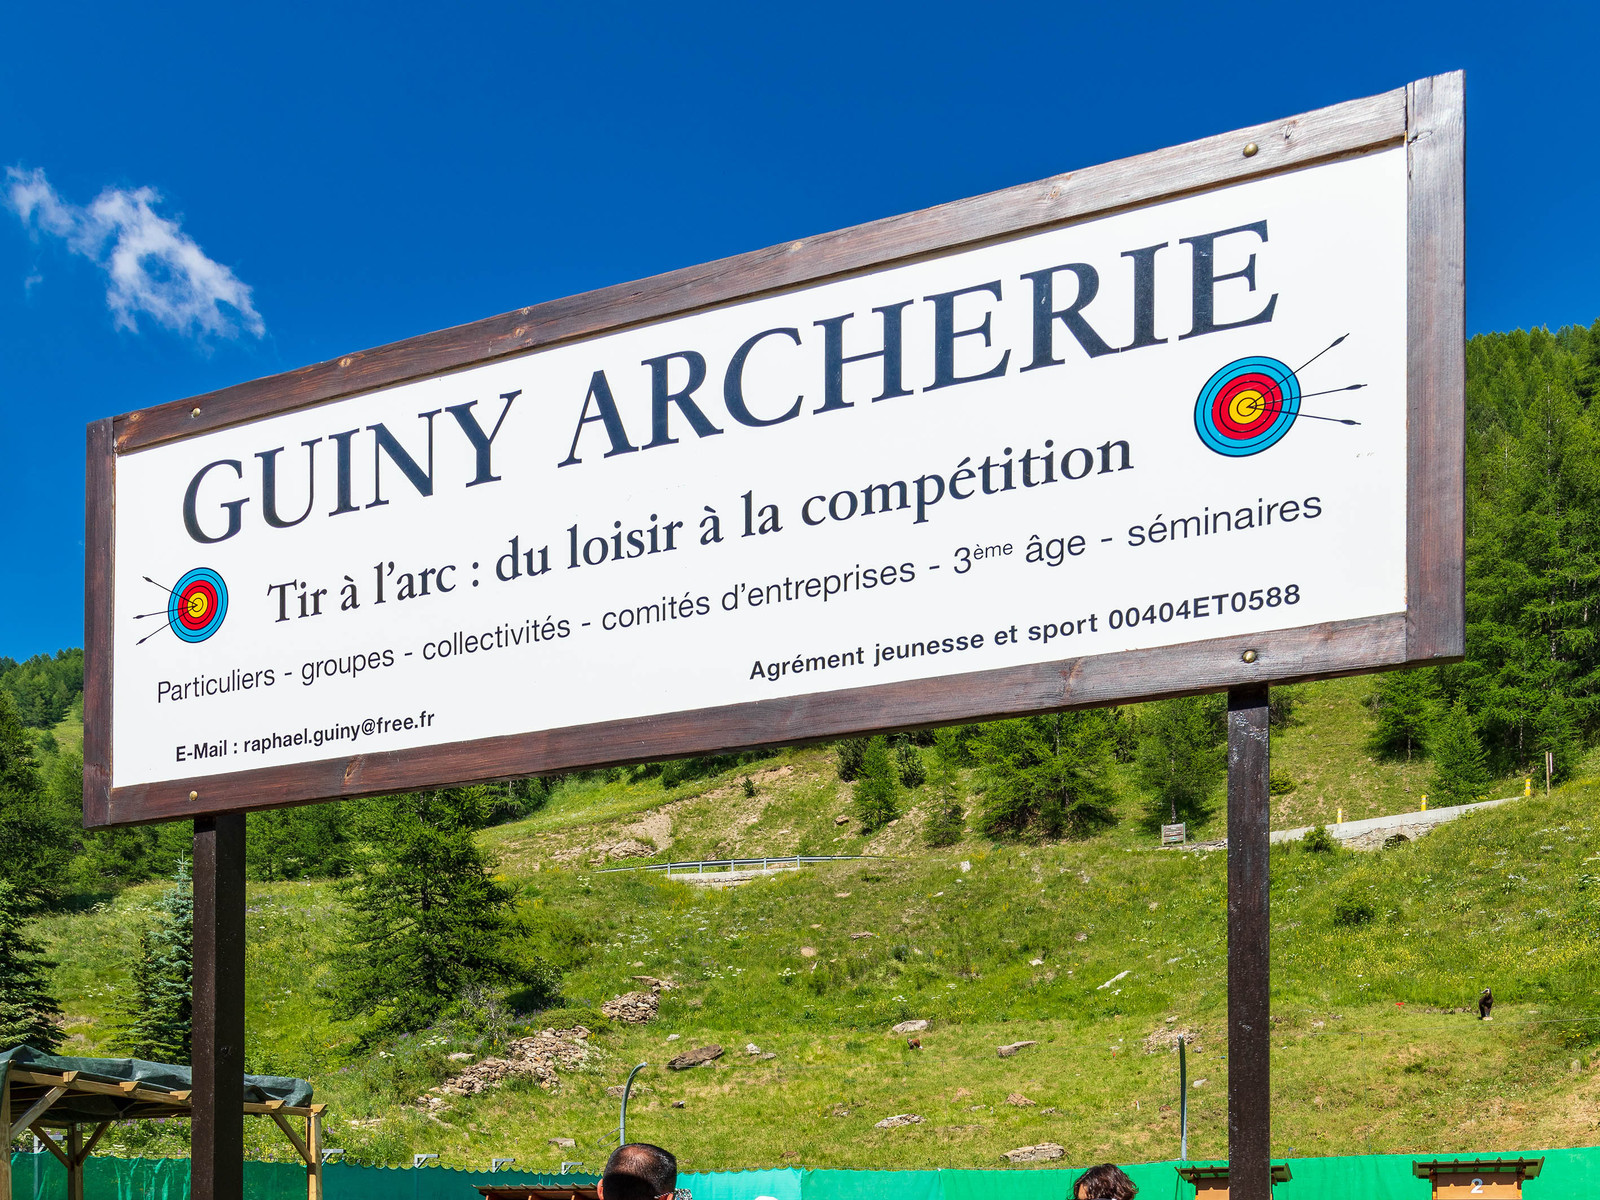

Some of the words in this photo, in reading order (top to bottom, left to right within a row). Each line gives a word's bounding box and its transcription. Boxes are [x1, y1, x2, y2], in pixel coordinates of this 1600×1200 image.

[183, 389, 522, 544] GUINY
[558, 219, 1278, 469] ARCHERIE
[157, 667, 275, 703] Particuliers
[302, 649, 394, 685] groupes
[422, 615, 571, 661] collectivités
[603, 591, 710, 631] comités
[721, 562, 915, 611] d’entreprises
[953, 540, 1013, 574] 3ème
[1026, 534, 1085, 567] âge
[1128, 496, 1322, 547] séminaires
[267, 578, 327, 622] Tir
[341, 574, 361, 611] à
[374, 561, 457, 605] l’arc
[473, 561, 479, 587] :
[496, 535, 551, 582] du
[567, 513, 683, 570] loisir
[700, 505, 724, 546] à
[741, 489, 783, 538] la
[802, 440, 1134, 526] compétition
[750, 646, 864, 682] Agrément
[873, 633, 985, 667] jeunesse
[995, 625, 1018, 646] et
[1028, 613, 1098, 644] sport
[1108, 583, 1301, 630] 00404ET0588
[176, 739, 227, 763] E-Mail
[233, 742, 238, 754] :
[244, 711, 435, 754] raphael.guiny@free.fr
[1470, 1178, 1484, 1194] 2
